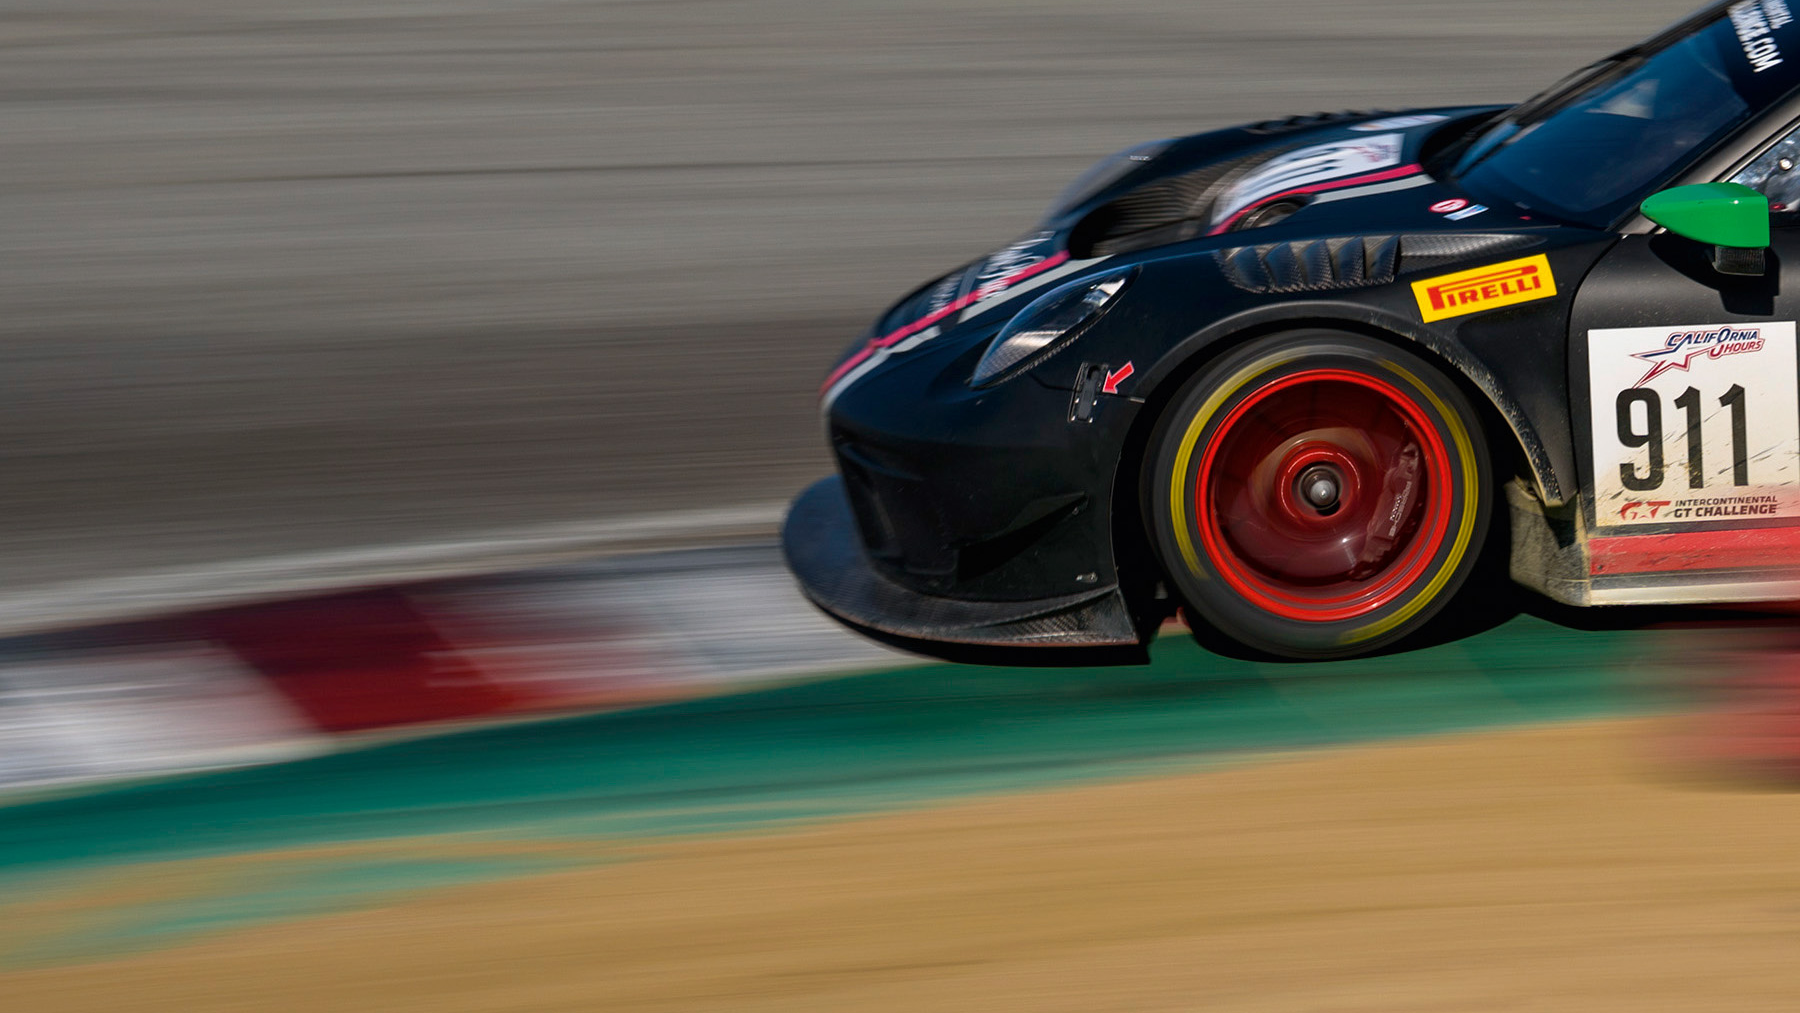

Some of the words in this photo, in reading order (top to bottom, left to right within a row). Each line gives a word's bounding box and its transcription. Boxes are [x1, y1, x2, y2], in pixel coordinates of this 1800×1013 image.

[1426, 264, 1542, 311] PIRELLI
[1667, 327, 1758, 347] CALIFORNIA
[1616, 383, 1748, 491] 911
[1673, 507, 1692, 518] GT
[1695, 504, 1777, 517] CHALLENGE
[1675, 495, 1778, 507] INTERCONTINENTAL
